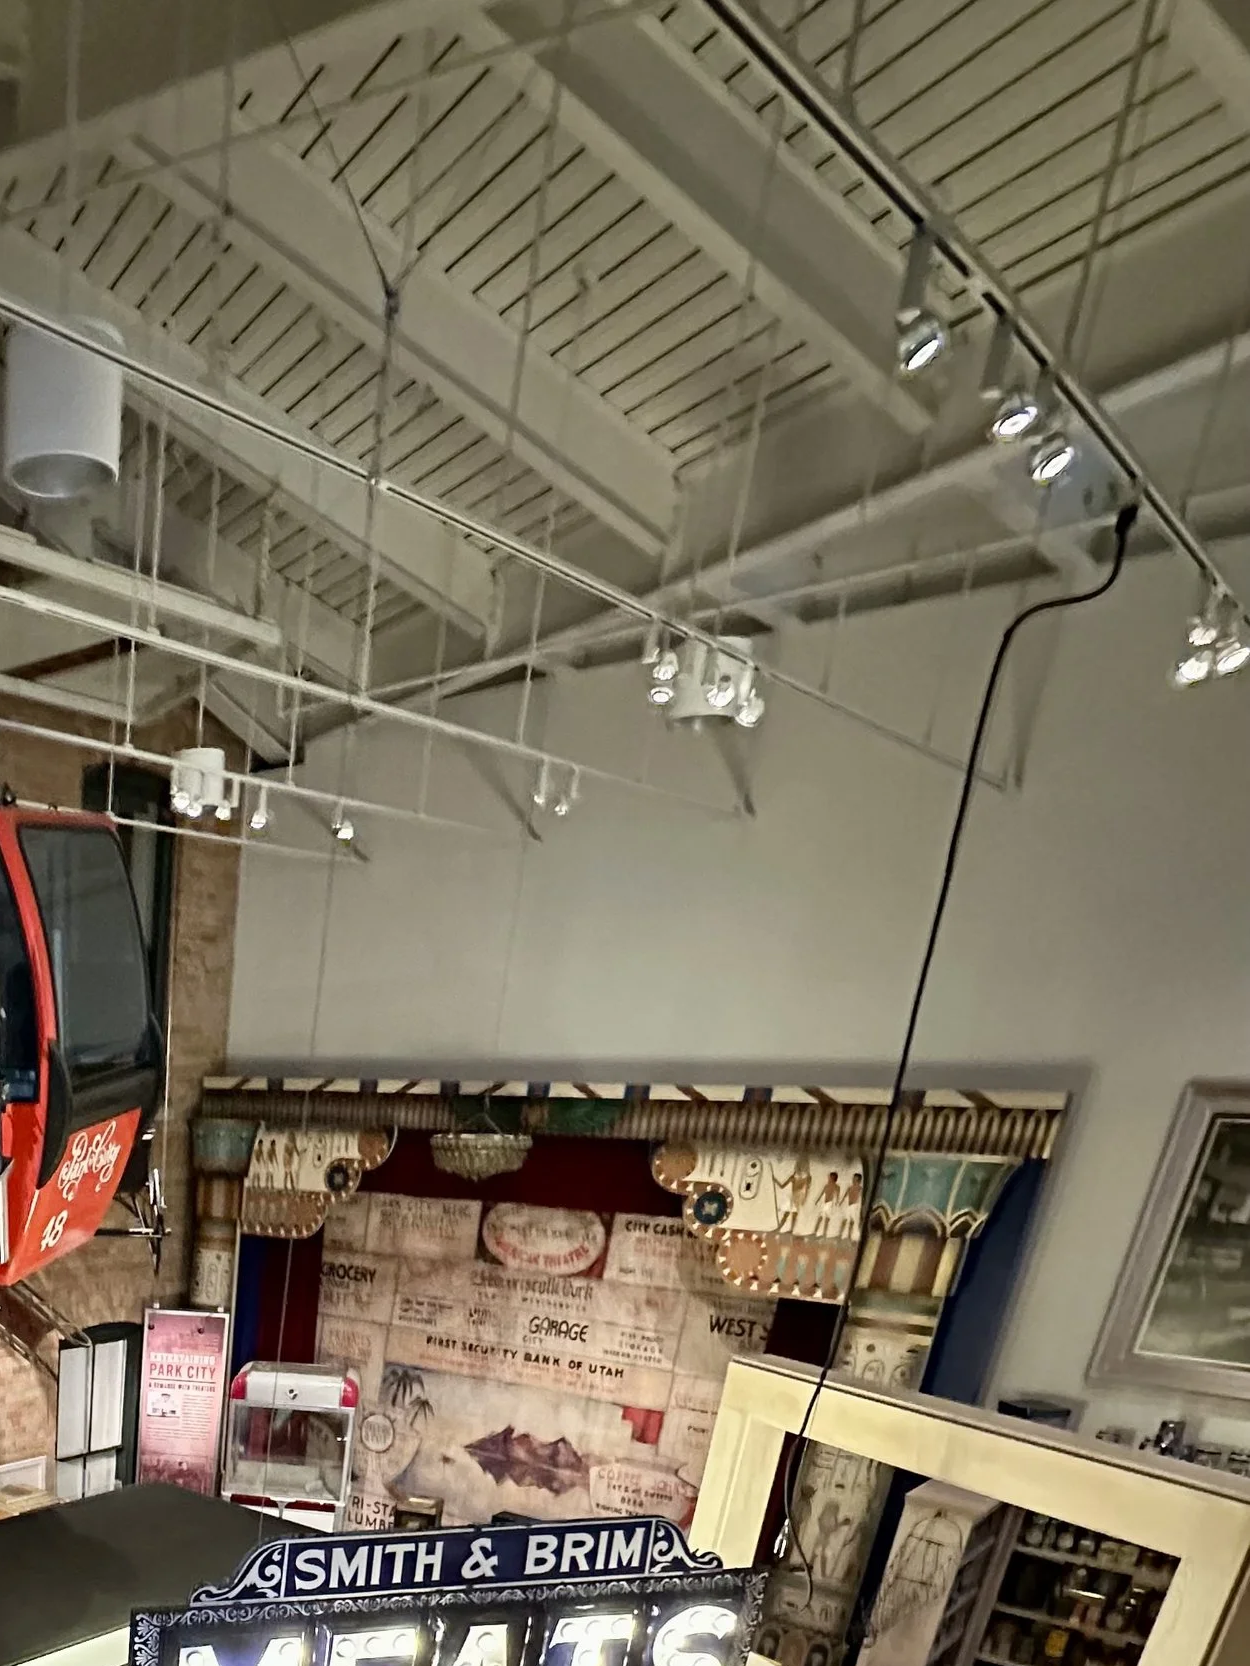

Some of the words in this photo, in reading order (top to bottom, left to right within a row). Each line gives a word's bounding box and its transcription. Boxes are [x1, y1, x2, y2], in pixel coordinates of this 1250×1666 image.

[625, 1219, 651, 1234] CITY
[653, 1222, 685, 1239] CASH
[529, 1315, 589, 1343] GARAGE
[709, 1314, 758, 1337] WEST
[425, 1334, 458, 1350] FIRST
[523, 1352, 560, 1368] BANK
[568, 1359, 583, 1371] OF
[589, 1363, 625, 1380] UTAH
[149, 1363, 182, 1378] PARK
[187, 1365, 216, 1380] CITY
[293, 1541, 443, 1591] SMITH
[461, 1536, 500, 1579] &
[524, 1526, 648, 1575] BRIM
